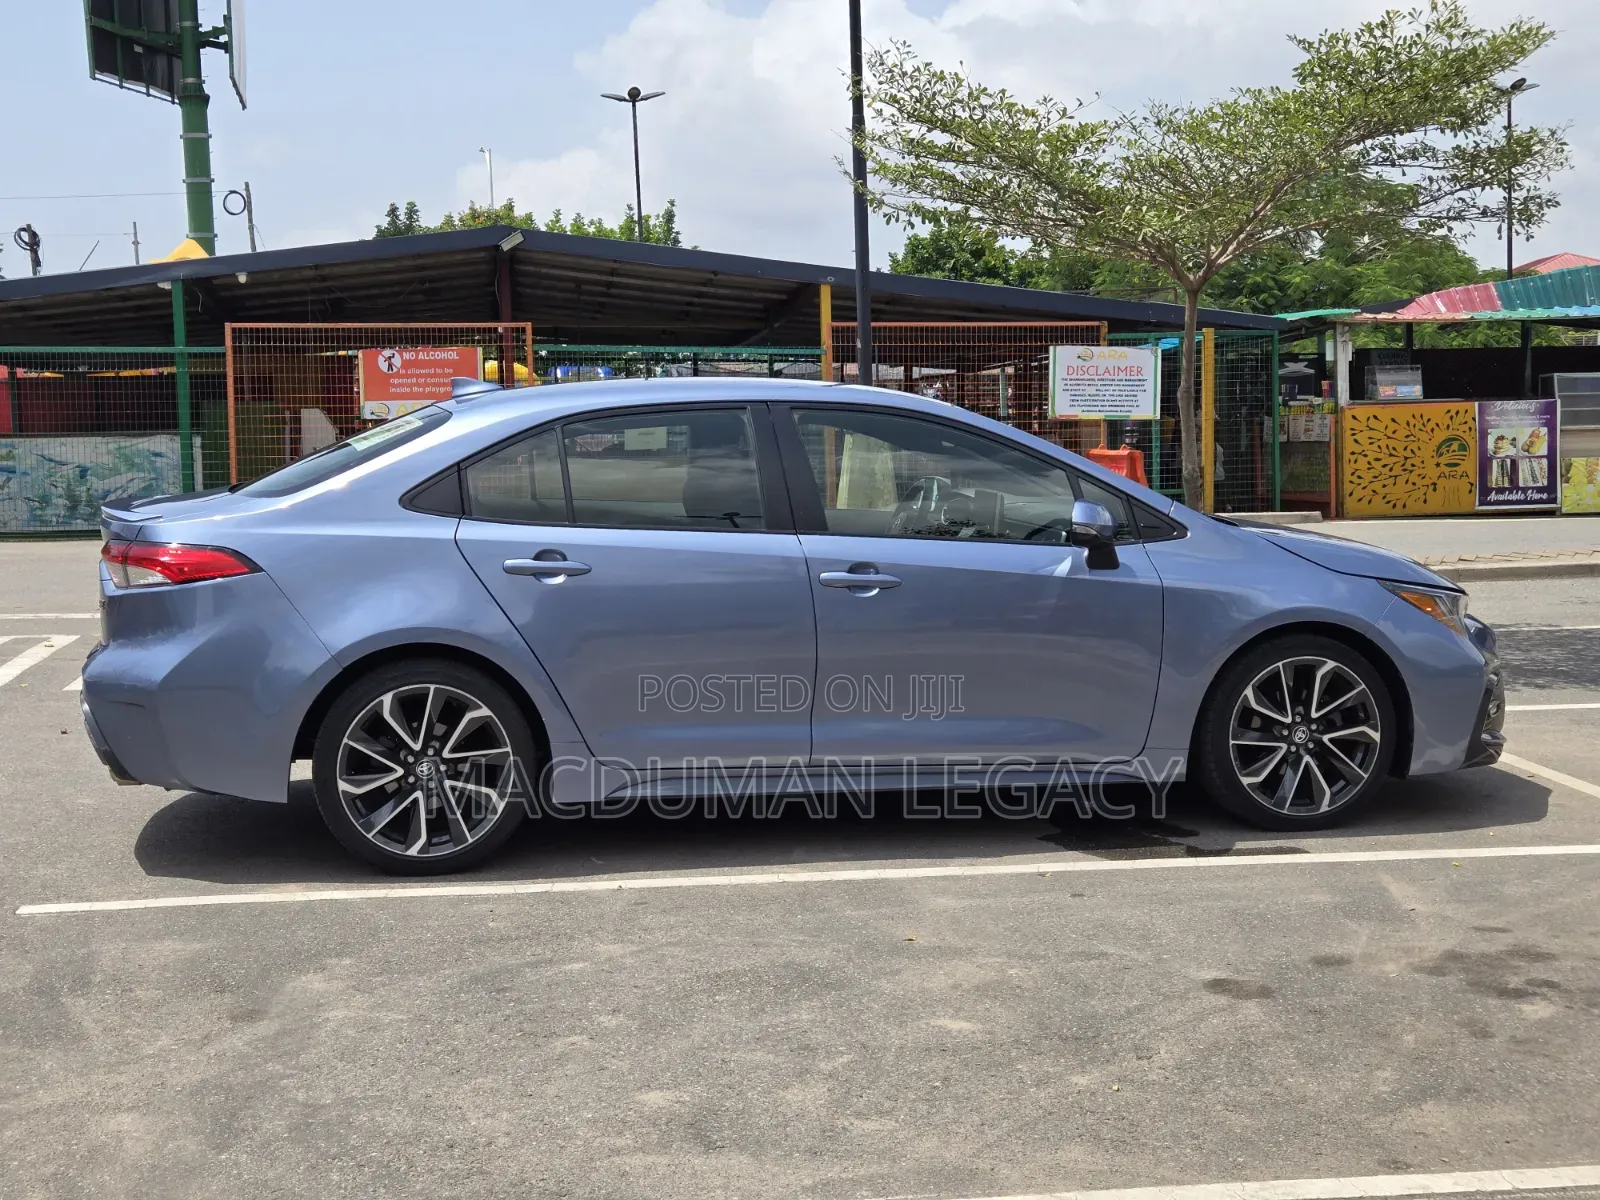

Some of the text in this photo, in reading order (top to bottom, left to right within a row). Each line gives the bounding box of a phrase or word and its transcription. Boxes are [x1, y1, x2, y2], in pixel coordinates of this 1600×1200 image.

[403, 351, 459, 360] NO ALCOHOL
[1097, 350, 1128, 360] ARA
[1066, 366, 1144, 376] DISCLAIMER
[1437, 470, 1470, 480] ARA
[1486, 489, 1549, 502] Available Here
